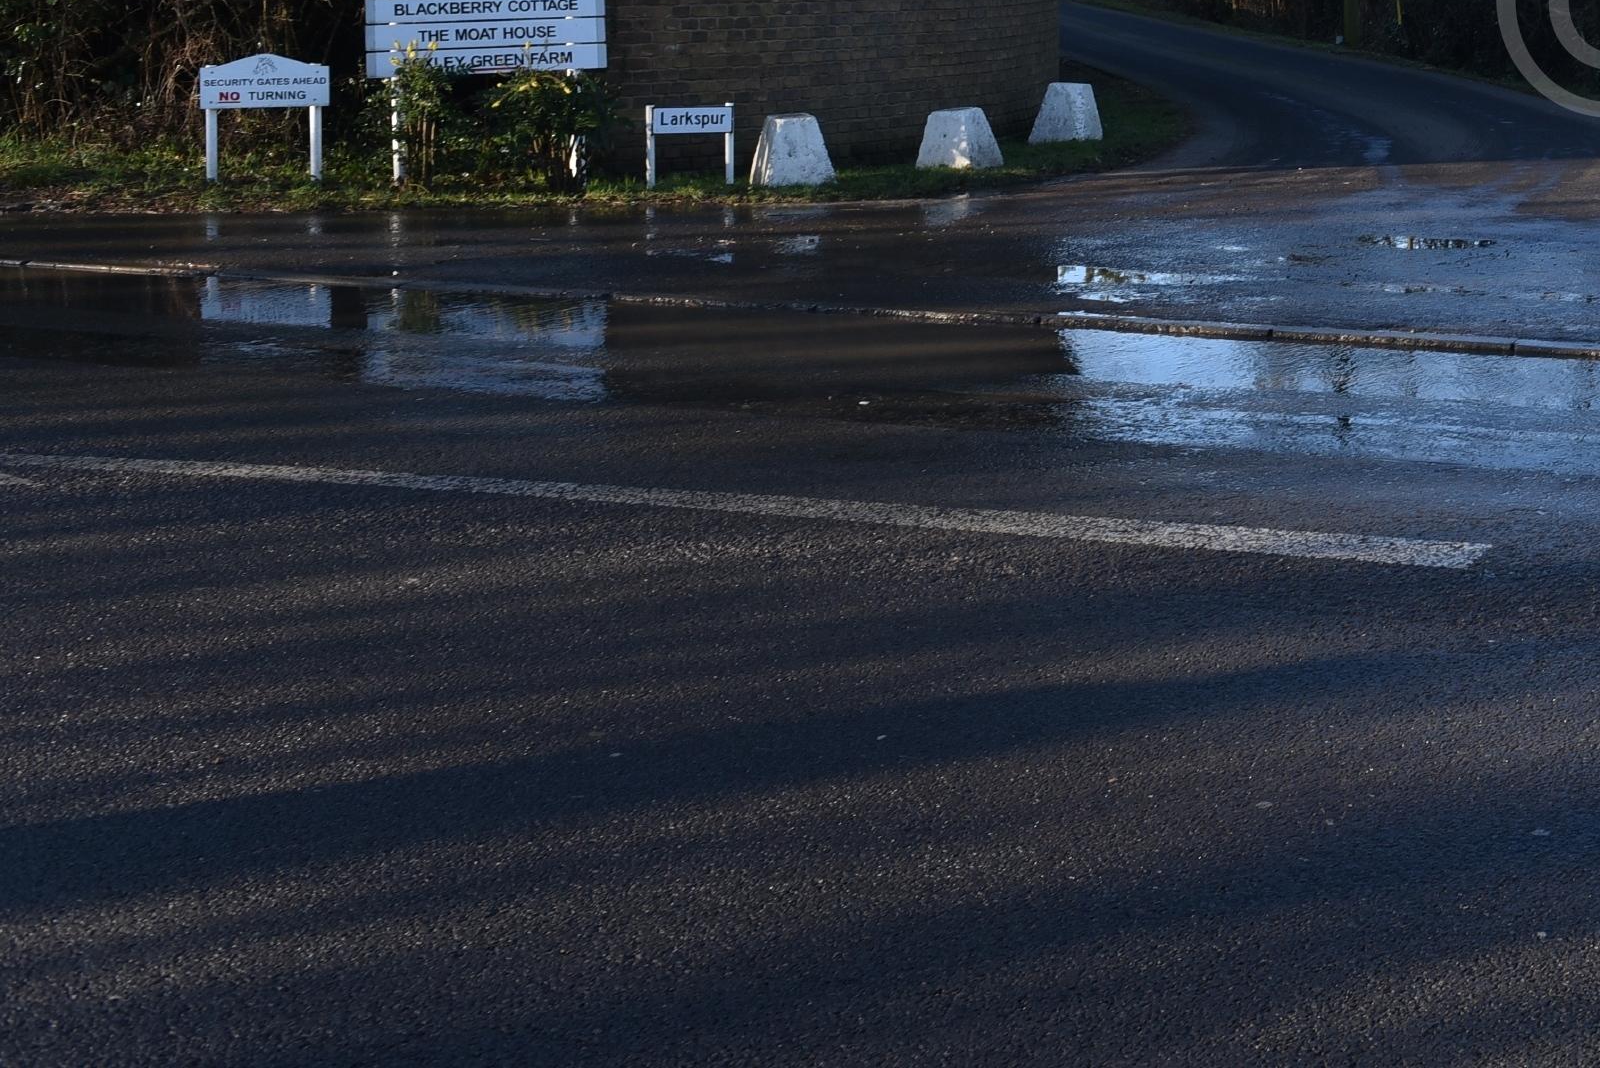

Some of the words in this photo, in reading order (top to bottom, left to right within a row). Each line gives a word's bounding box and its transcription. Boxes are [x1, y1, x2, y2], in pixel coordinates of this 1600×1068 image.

[394, 1, 503, 17] BLACKBERRY
[507, 0, 579, 13] COTTAGE
[418, 29, 450, 42] THE
[455, 28, 498, 41] MOAT
[503, 26, 556, 40] HOUSE
[403, 56, 464, 69] XLEY
[471, 54, 525, 68] GREEN
[530, 52, 573, 65] FARM
[203, 79, 254, 87] SECURITY
[256, 78, 290, 86] GATES
[292, 77, 327, 85] AHEAD
[219, 91, 241, 101] NO
[248, 90, 307, 101] TURNING
[660, 112, 726, 128] Larkspur
